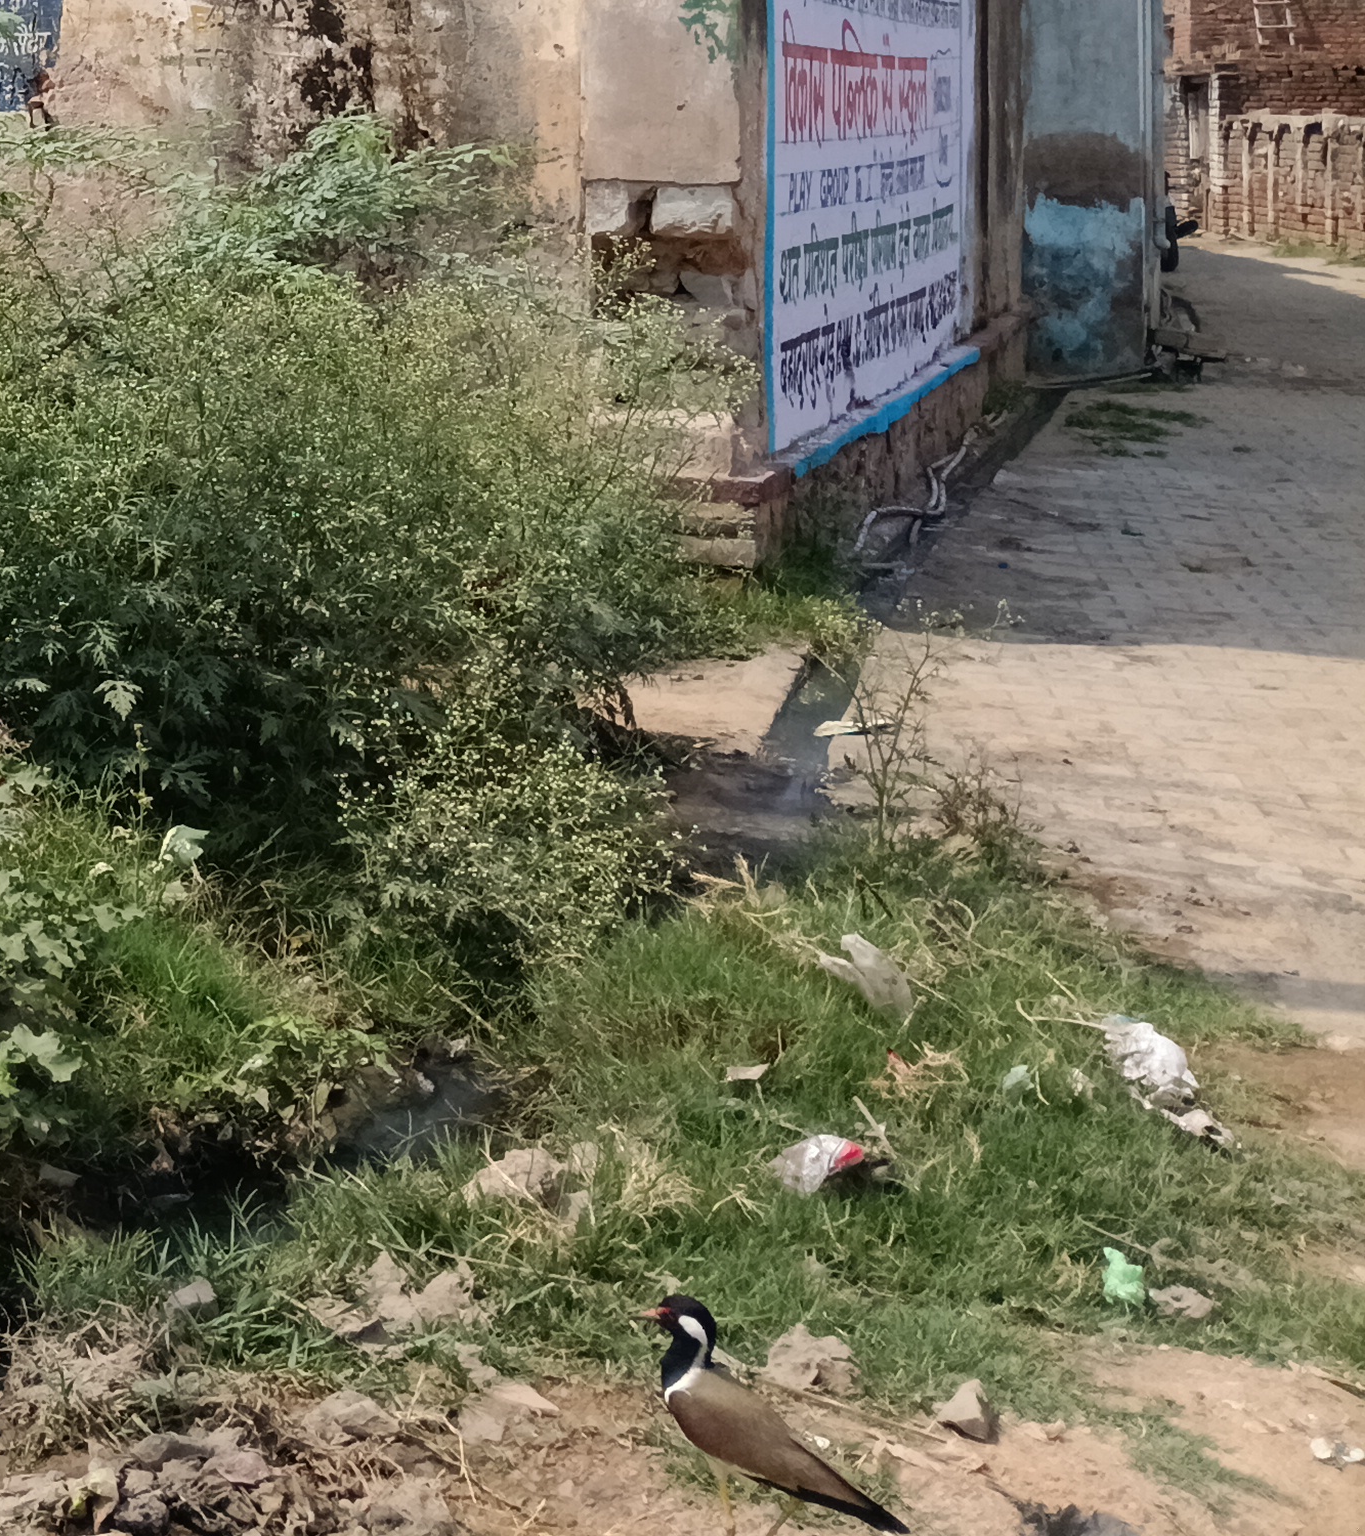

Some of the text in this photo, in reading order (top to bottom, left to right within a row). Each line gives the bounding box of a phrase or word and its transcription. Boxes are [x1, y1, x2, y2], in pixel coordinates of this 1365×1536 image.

[782, 8, 829, 149] विकास
[830, 17, 879, 145] पब्लिक
[897, 56, 929, 147] स्कूल
[788, 170, 815, 214] PLAY
[819, 166, 850, 208] GROUP
[802, 221, 840, 301] प्रतिशत
[840, 210, 870, 293] परीक्षा
